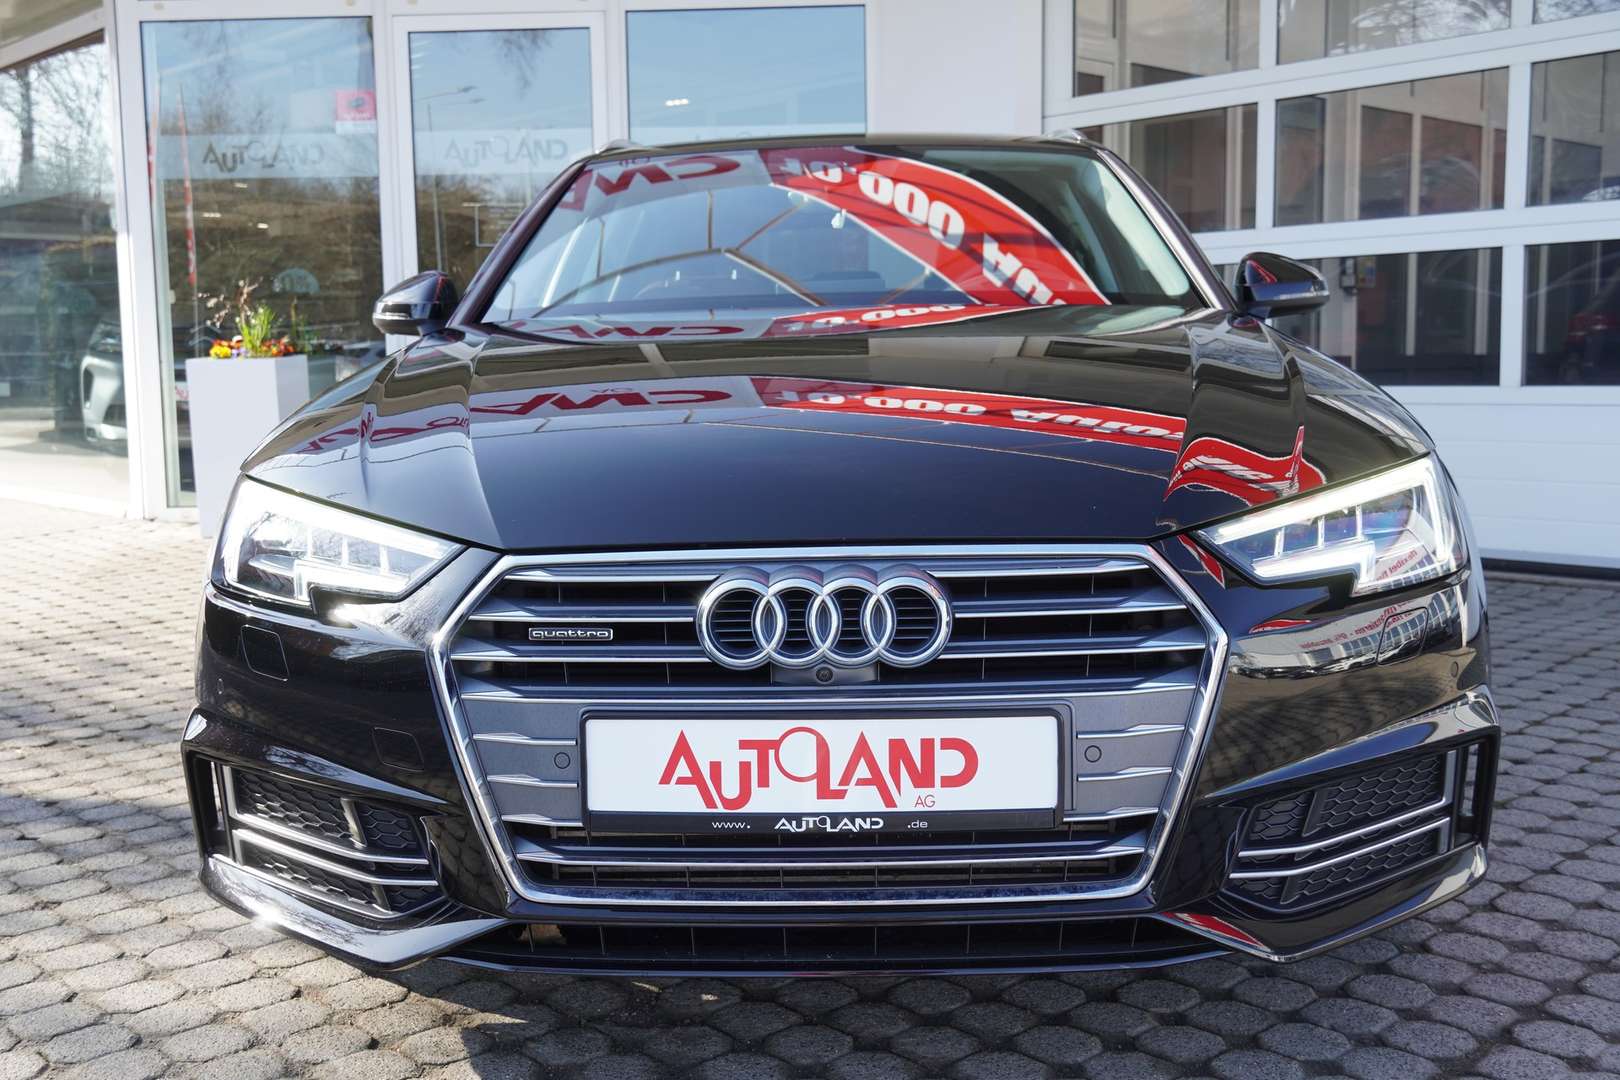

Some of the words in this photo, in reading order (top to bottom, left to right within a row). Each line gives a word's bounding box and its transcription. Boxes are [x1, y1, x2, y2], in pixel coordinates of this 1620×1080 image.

[531, 629, 610, 641] quattro
[658, 726, 979, 810] AUTOLAND
[914, 795, 936, 809] AG
[711, 819, 751, 830] www.
[906, 818, 928, 830] .de
